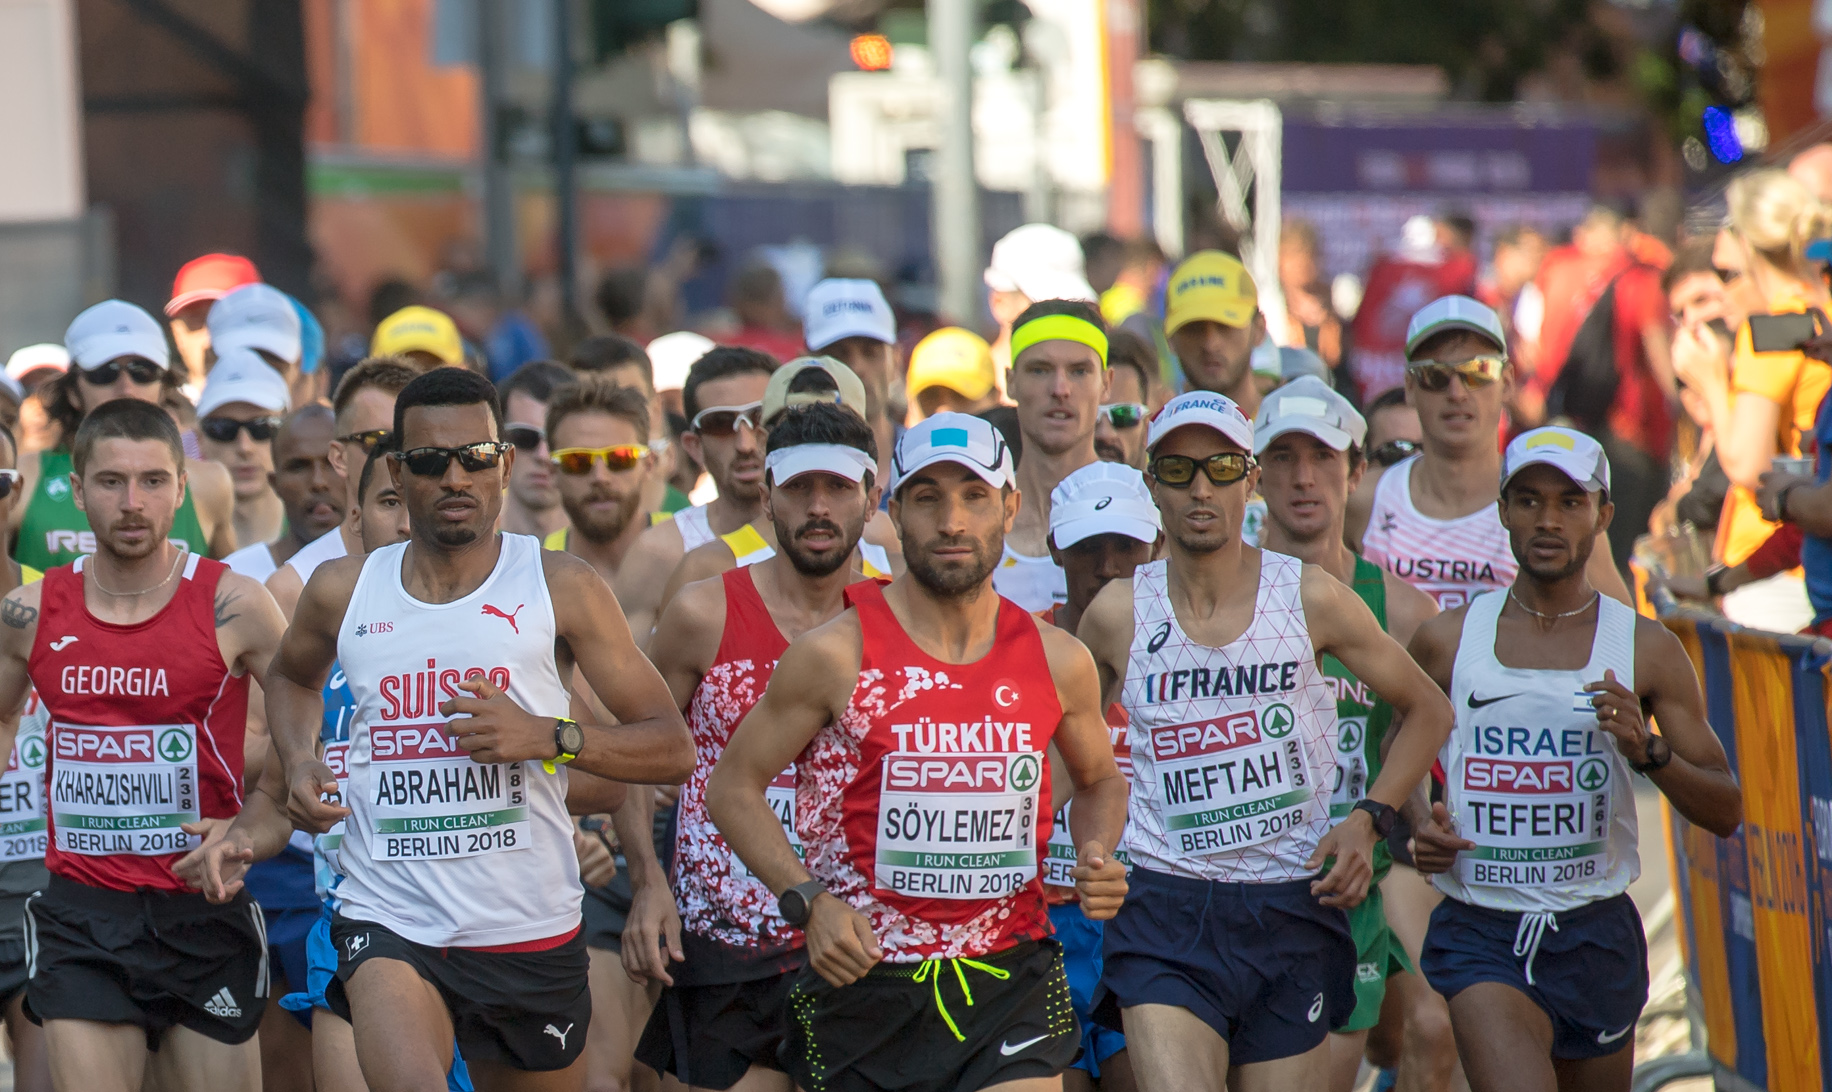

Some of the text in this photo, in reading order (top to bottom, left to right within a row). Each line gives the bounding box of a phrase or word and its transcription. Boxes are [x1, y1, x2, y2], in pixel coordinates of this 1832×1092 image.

[1173, 399, 1226, 414] FRANCE
[1386, 553, 1496, 582] USTRIA
[369, 621, 394, 634] UBS
[61, 665, 170, 697] GEORGIA
[1171, 660, 1299, 701] FRANCE
[57, 731, 152, 759] SPAR
[372, 728, 461, 756] SPA
[890, 715, 1033, 753] TÜRKİYE
[1154, 715, 1258, 756] SPAR
[1474, 725, 1604, 757] ISRAEL
[889, 760, 1004, 788] SPAR
[1287, 740, 1306, 787] 233
[1467, 761, 1571, 790] SPAR
[56, 769, 173, 806] KHARAZISHVILI
[179, 768, 192, 810] 238
[376, 764, 501, 806] ABRAHAM
[1162, 751, 1283, 806] MEFTAH
[88, 817, 115, 829] RUN
[410, 817, 440, 831] RUN
[884, 801, 1016, 843] SÖYLEMEZ
[1020, 797, 1033, 846] 301
[1202, 809, 1229, 824] RUN
[1467, 801, 1585, 837] TEFERI
[1594, 794, 1605, 837] 261
[67, 831, 188, 852] BERLIN 2018
[387, 828, 516, 857] BERLIN 2018
[1180, 809, 1303, 852] BERLIN 2018
[4, 835, 48, 856] 2018
[1499, 849, 1528, 860] RUN
[924, 854, 955, 867] RUN
[1474, 860, 1596, 884] BERLIN 2018
[891, 870, 972, 894] BERLIN
[978, 872, 1025, 894] 2018
